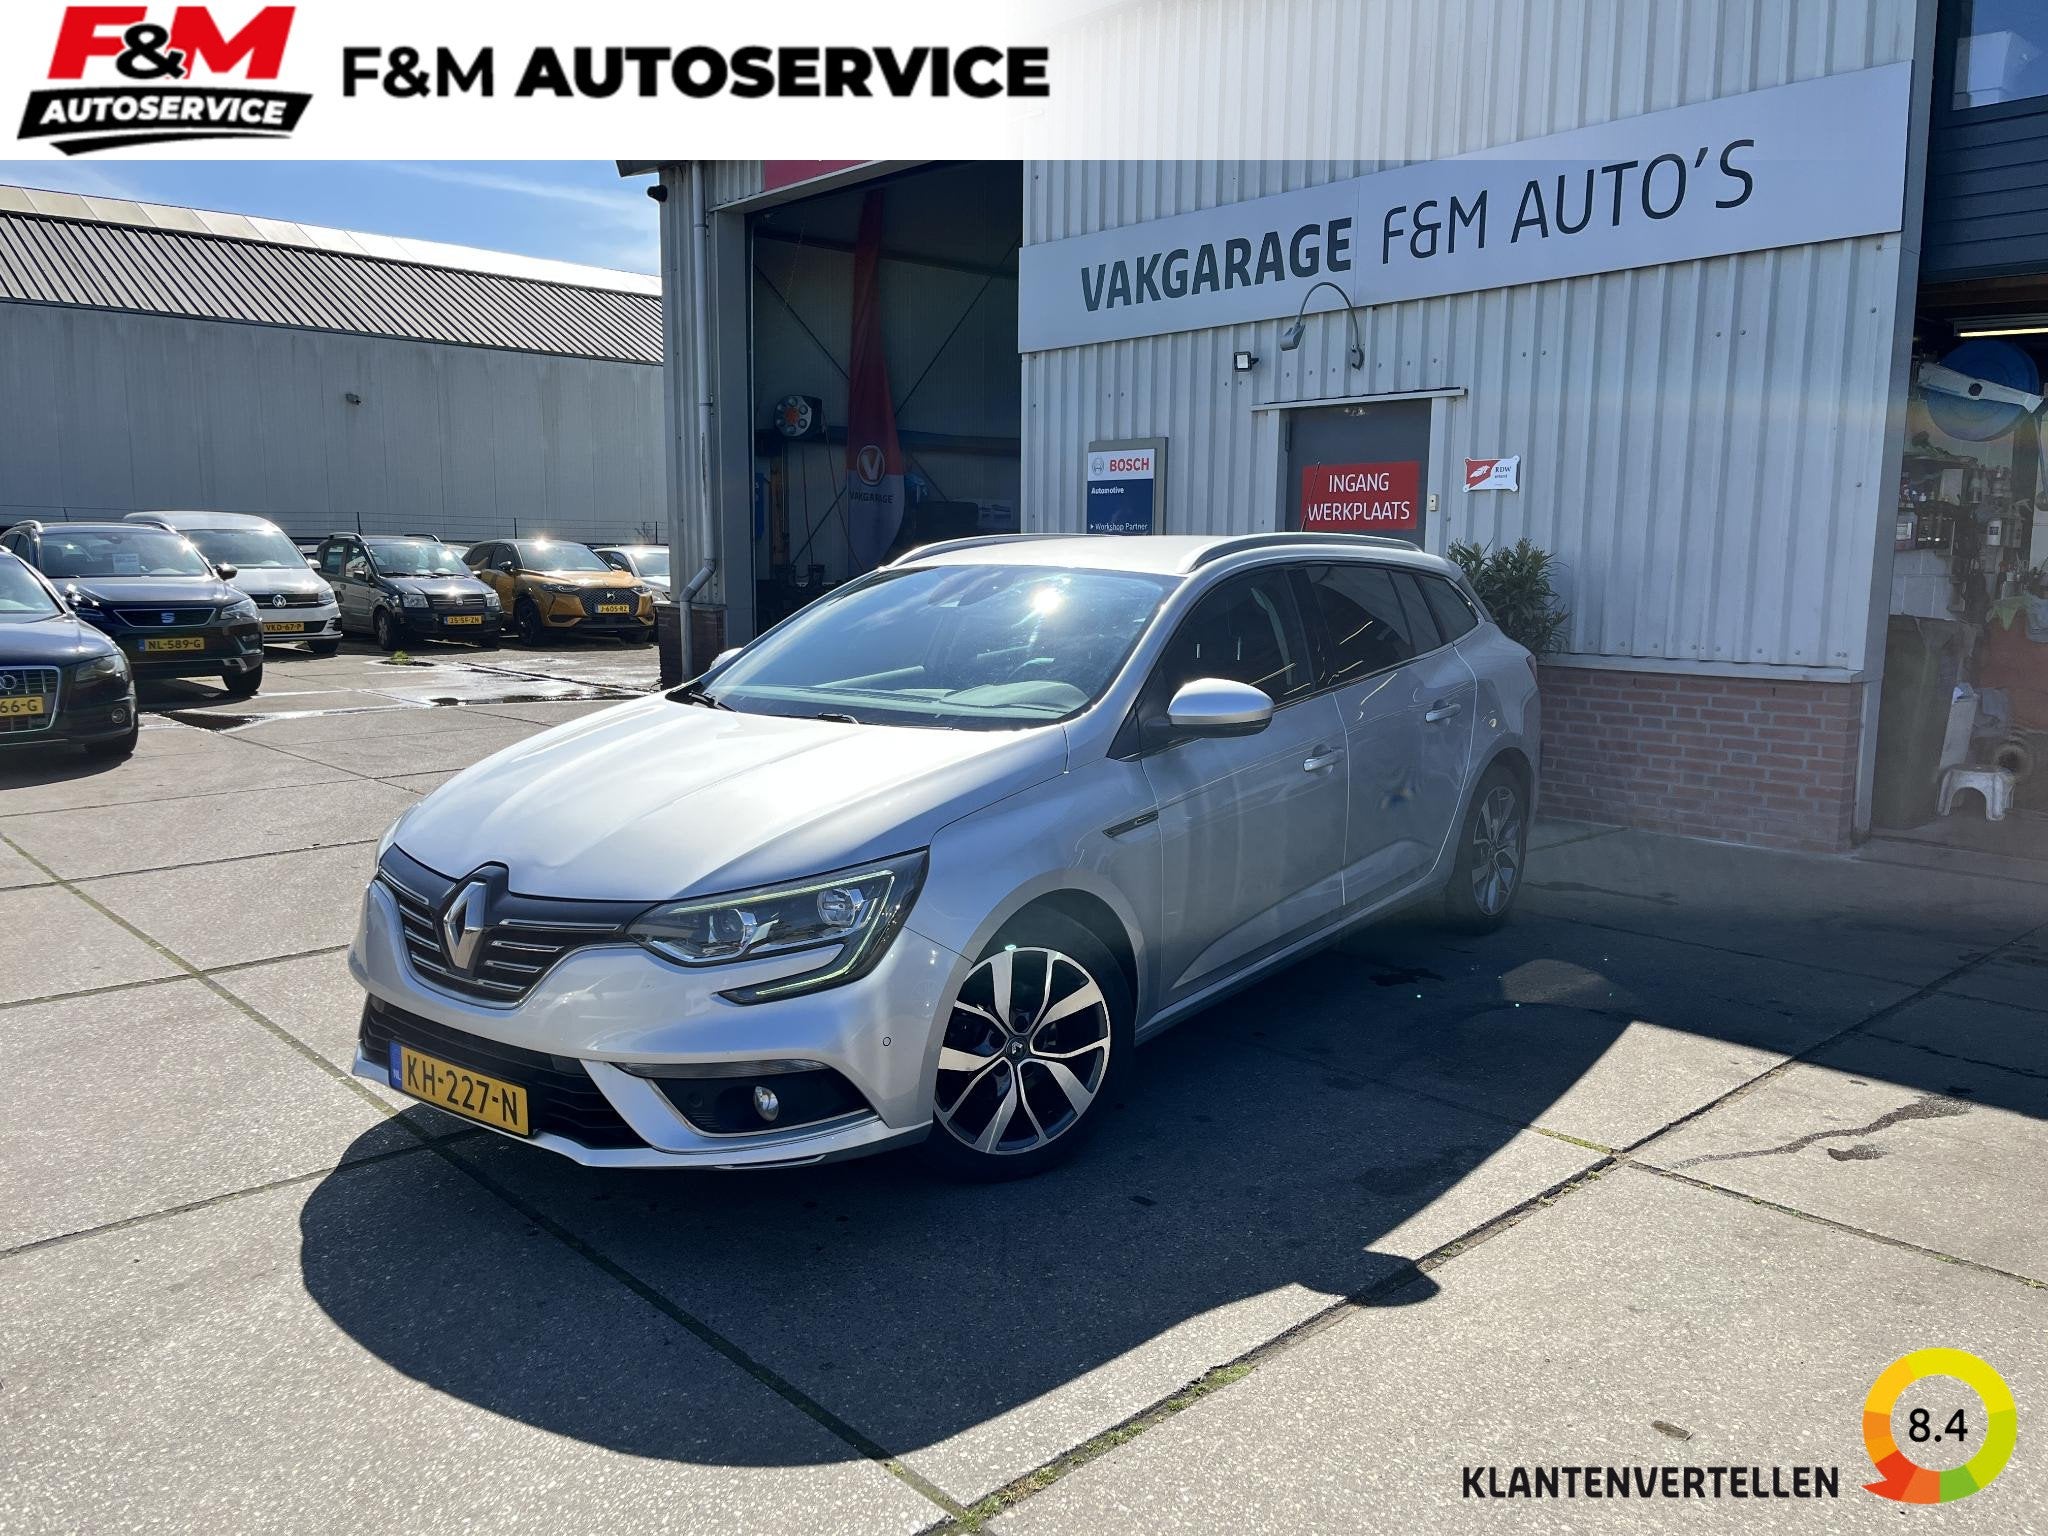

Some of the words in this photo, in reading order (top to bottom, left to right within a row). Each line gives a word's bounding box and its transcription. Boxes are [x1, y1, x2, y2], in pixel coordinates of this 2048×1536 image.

[1081, 217, 1353, 312] VAKGARAGE
[1382, 190, 1488, 264] F&M
[1511, 139, 1756, 243] AUTO'S
[1109, 458, 1150, 473] BOSCH
[1091, 486, 1125, 495] Automotive
[1329, 473, 1390, 493] INGANG
[1308, 501, 1410, 521] WERKPLAATS
[1095, 523, 1124, 532] Workshop
[1125, 522, 1148, 531] Partner
[148, 638, 201, 650] NL-589-G
[407, 1054, 518, 1126] KH-227-N
